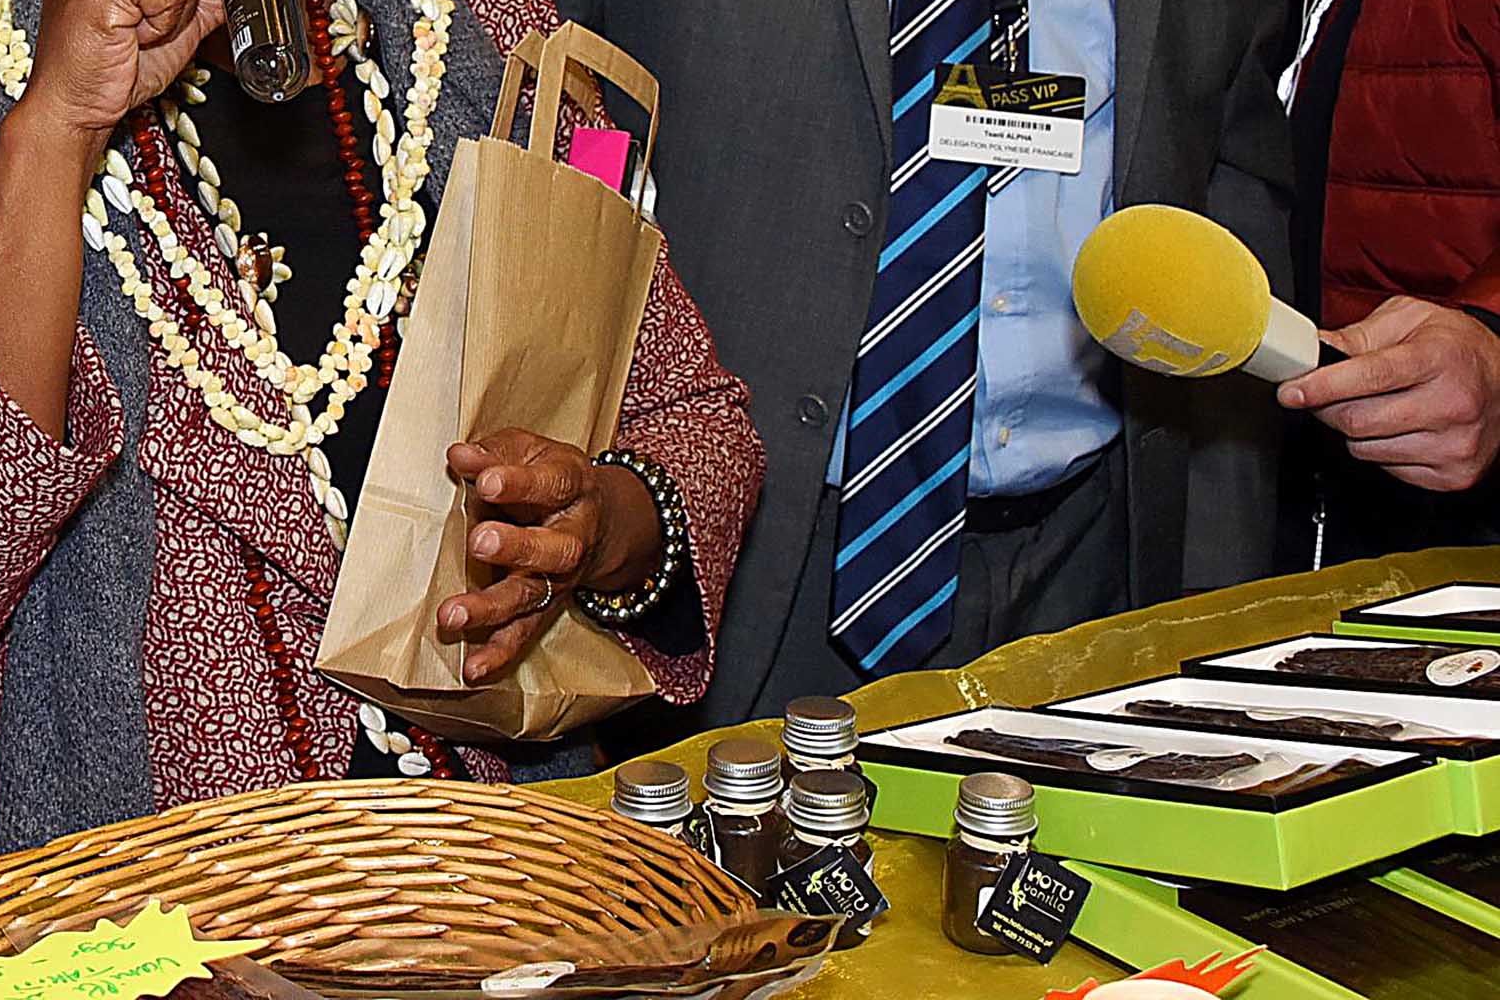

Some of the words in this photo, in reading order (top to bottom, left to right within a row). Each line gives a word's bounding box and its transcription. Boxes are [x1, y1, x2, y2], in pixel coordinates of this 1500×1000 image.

[990, 88, 1029, 107] PASS
[1032, 82, 1060, 100] VIP
[1006, 132, 1033, 142] ALPHA
[823, 876, 855, 919] vanilla
[831, 866, 870, 912] HOTU
[1023, 882, 1066, 913] vanilla
[1026, 867, 1075, 902] HOTU
